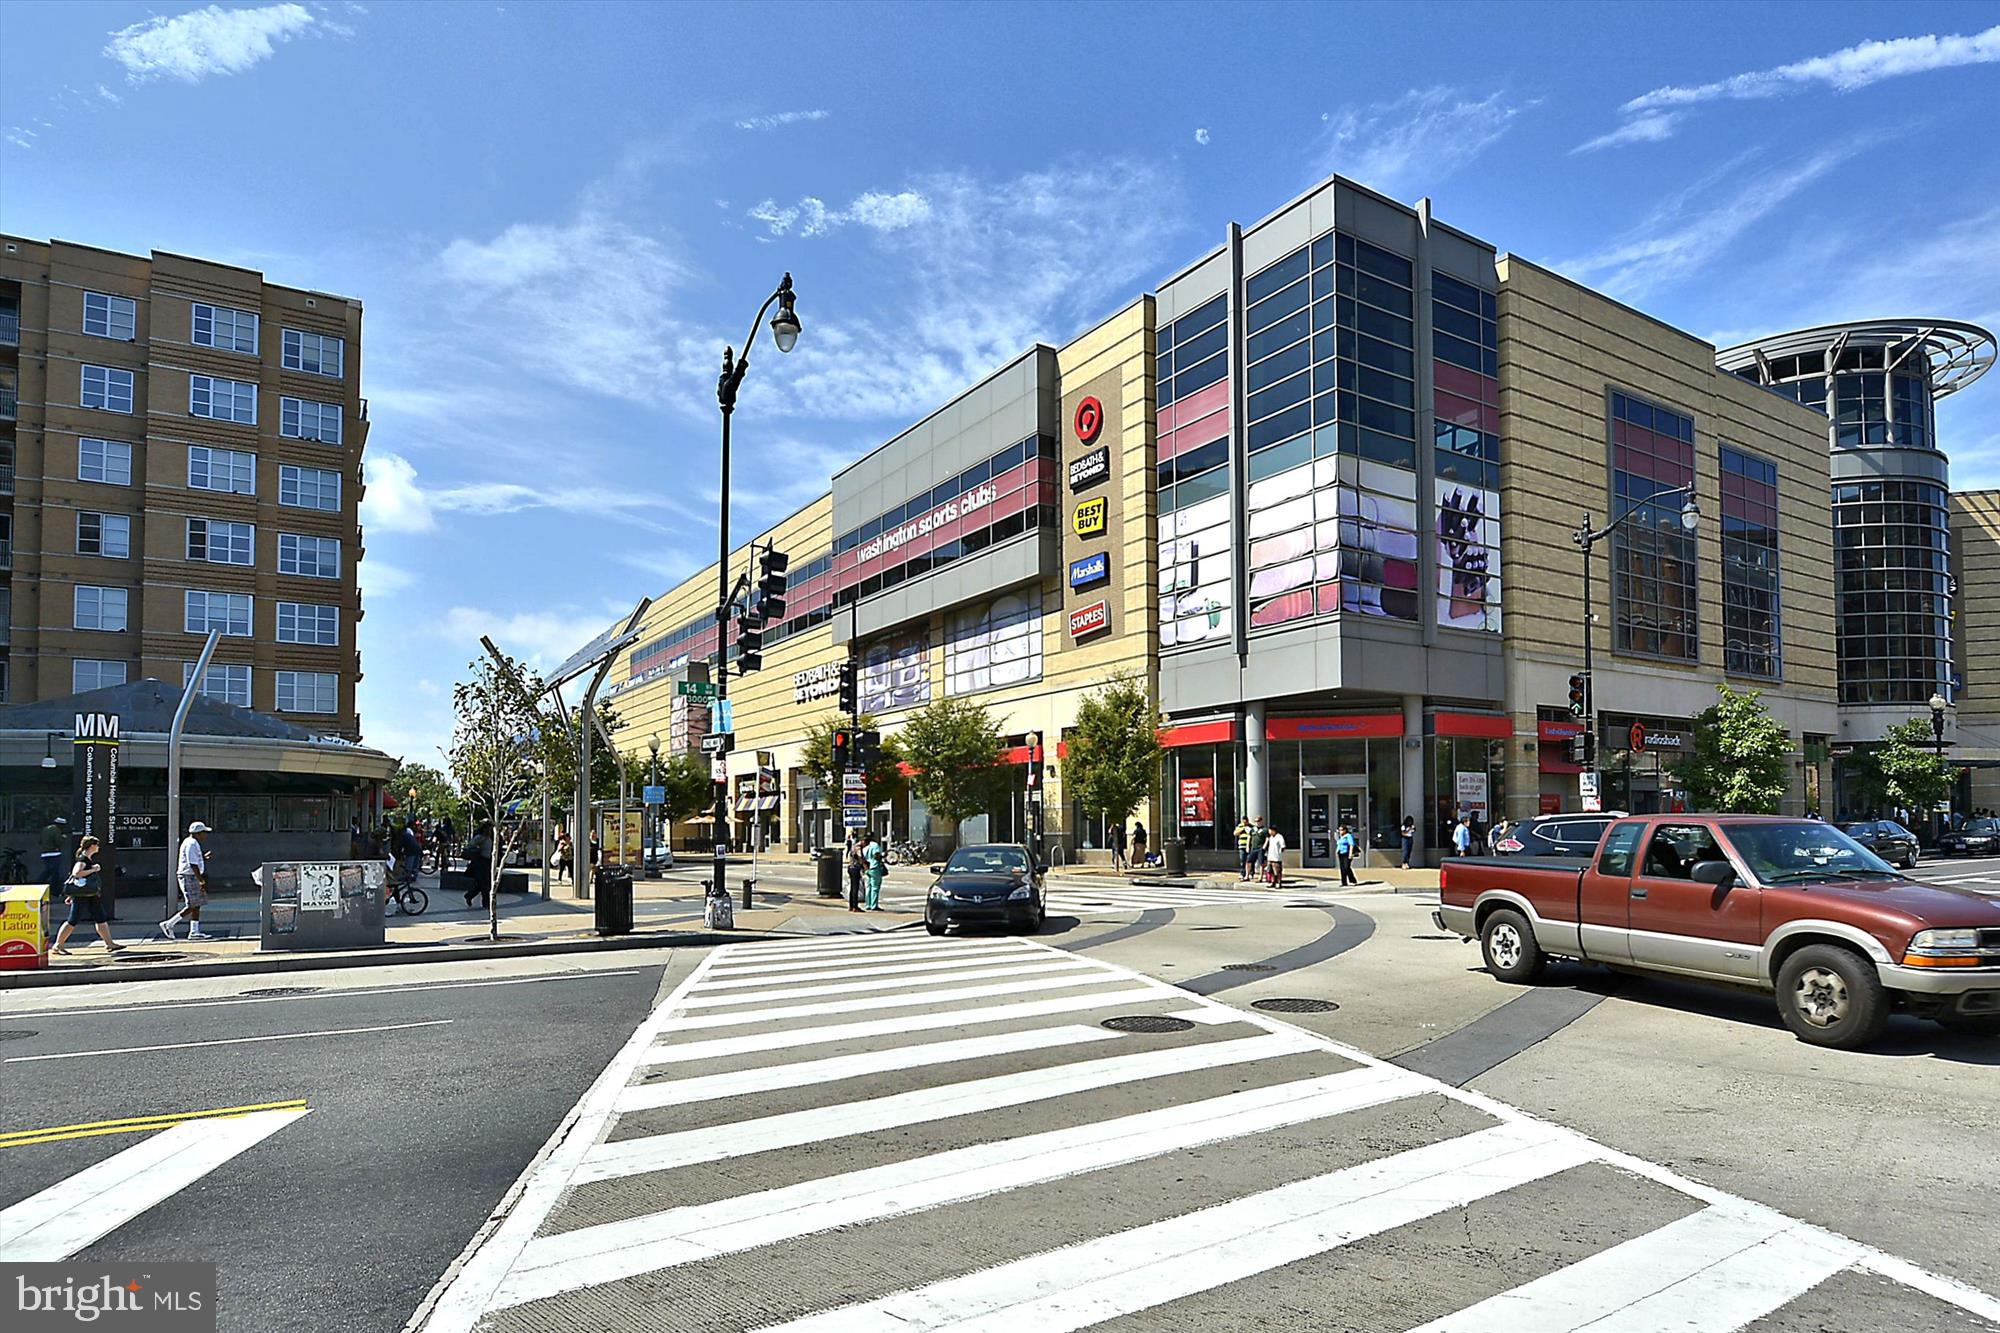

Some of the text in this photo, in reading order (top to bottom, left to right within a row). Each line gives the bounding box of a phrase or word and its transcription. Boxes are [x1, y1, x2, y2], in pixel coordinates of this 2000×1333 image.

[1070, 462, 1105, 484] BEYOND
[1077, 503, 1102, 519] BEST
[856, 484, 997, 562] washington sports clubs
[1078, 515, 1099, 530] BUY
[1071, 559, 1104, 581] Marshalls
[1071, 607, 1104, 631] STAPLES
[685, 683, 698, 694] 14
[1644, 733, 1681, 747] radioshack
[86, 746, 94, 782] Columbia
[85, 784, 93, 813] Heights
[108, 748, 118, 844] Columbia Heights Station
[123, 816, 152, 825] 3030
[3, 921, 37, 931] Latino
